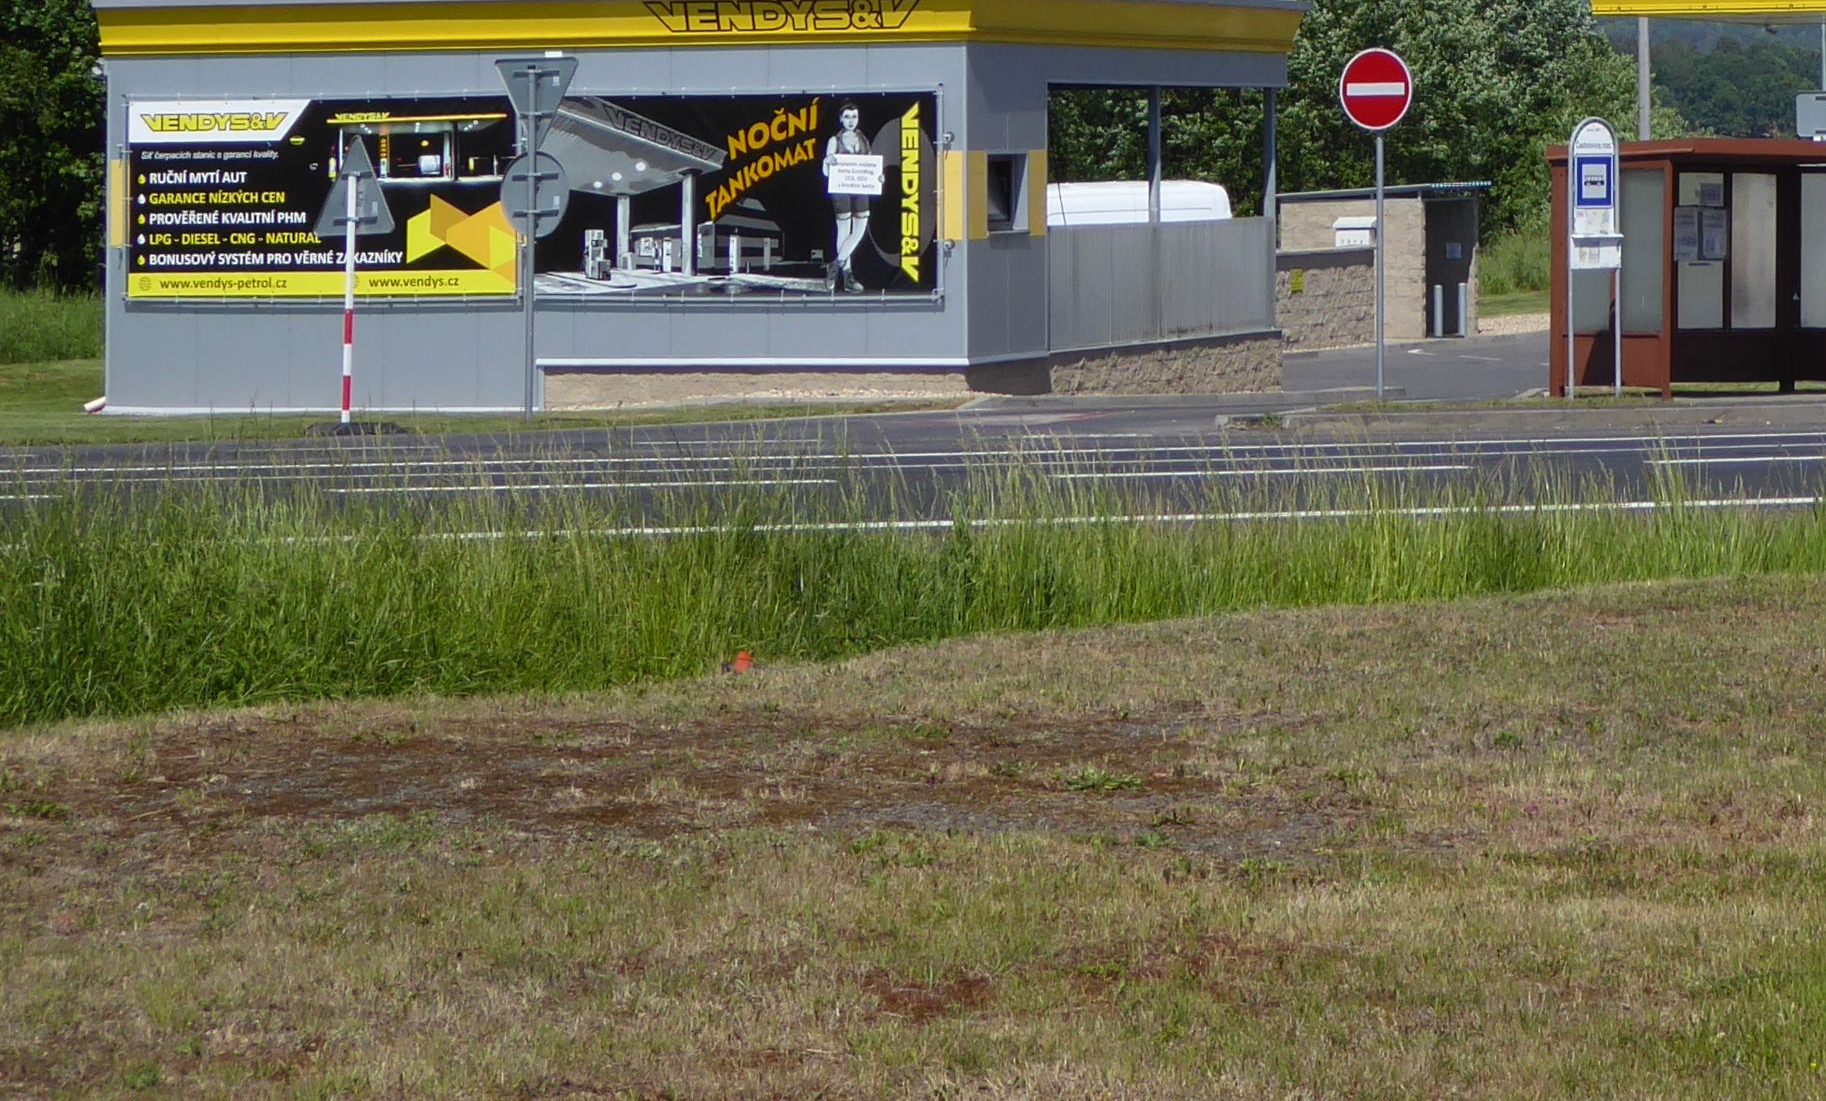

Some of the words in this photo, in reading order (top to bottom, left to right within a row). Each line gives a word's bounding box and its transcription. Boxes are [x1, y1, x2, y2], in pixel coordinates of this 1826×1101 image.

[140, 112, 289, 132] VENDYS&V
[727, 97, 820, 161] NOČNÍ
[602, 104, 715, 160] VENDYS&V
[150, 170, 186, 184] RUČNÍ
[190, 169, 220, 183] MYTÍ
[222, 171, 247, 183] AUT
[705, 137, 816, 220] TANKOMAT
[150, 192, 206, 204] GARANCE
[209, 189, 258, 204] NÍZKÝCH
[261, 192, 285, 203] CEN
[901, 101, 920, 282] VENDYS&V
[149, 210, 219, 225] PROVĚŘENÉ
[222, 209, 275, 224] KVALITNÍ
[278, 212, 306, 224] PHM
[149, 234, 172, 245] LPG
[182, 233, 220, 245] DIESEL
[230, 233, 255, 245] CNG
[266, 232, 321, 244] NATURAL
[149, 250, 216, 265] BONUSOVÝ
[218, 250, 263, 265] SYSTÉM
[266, 253, 291, 264] PRO
[294, 250, 334, 264] VĚRNÉ
[160, 278, 287, 290] www.vendys-petrol.cz
[368, 276, 459, 291] www.vendys.cz
